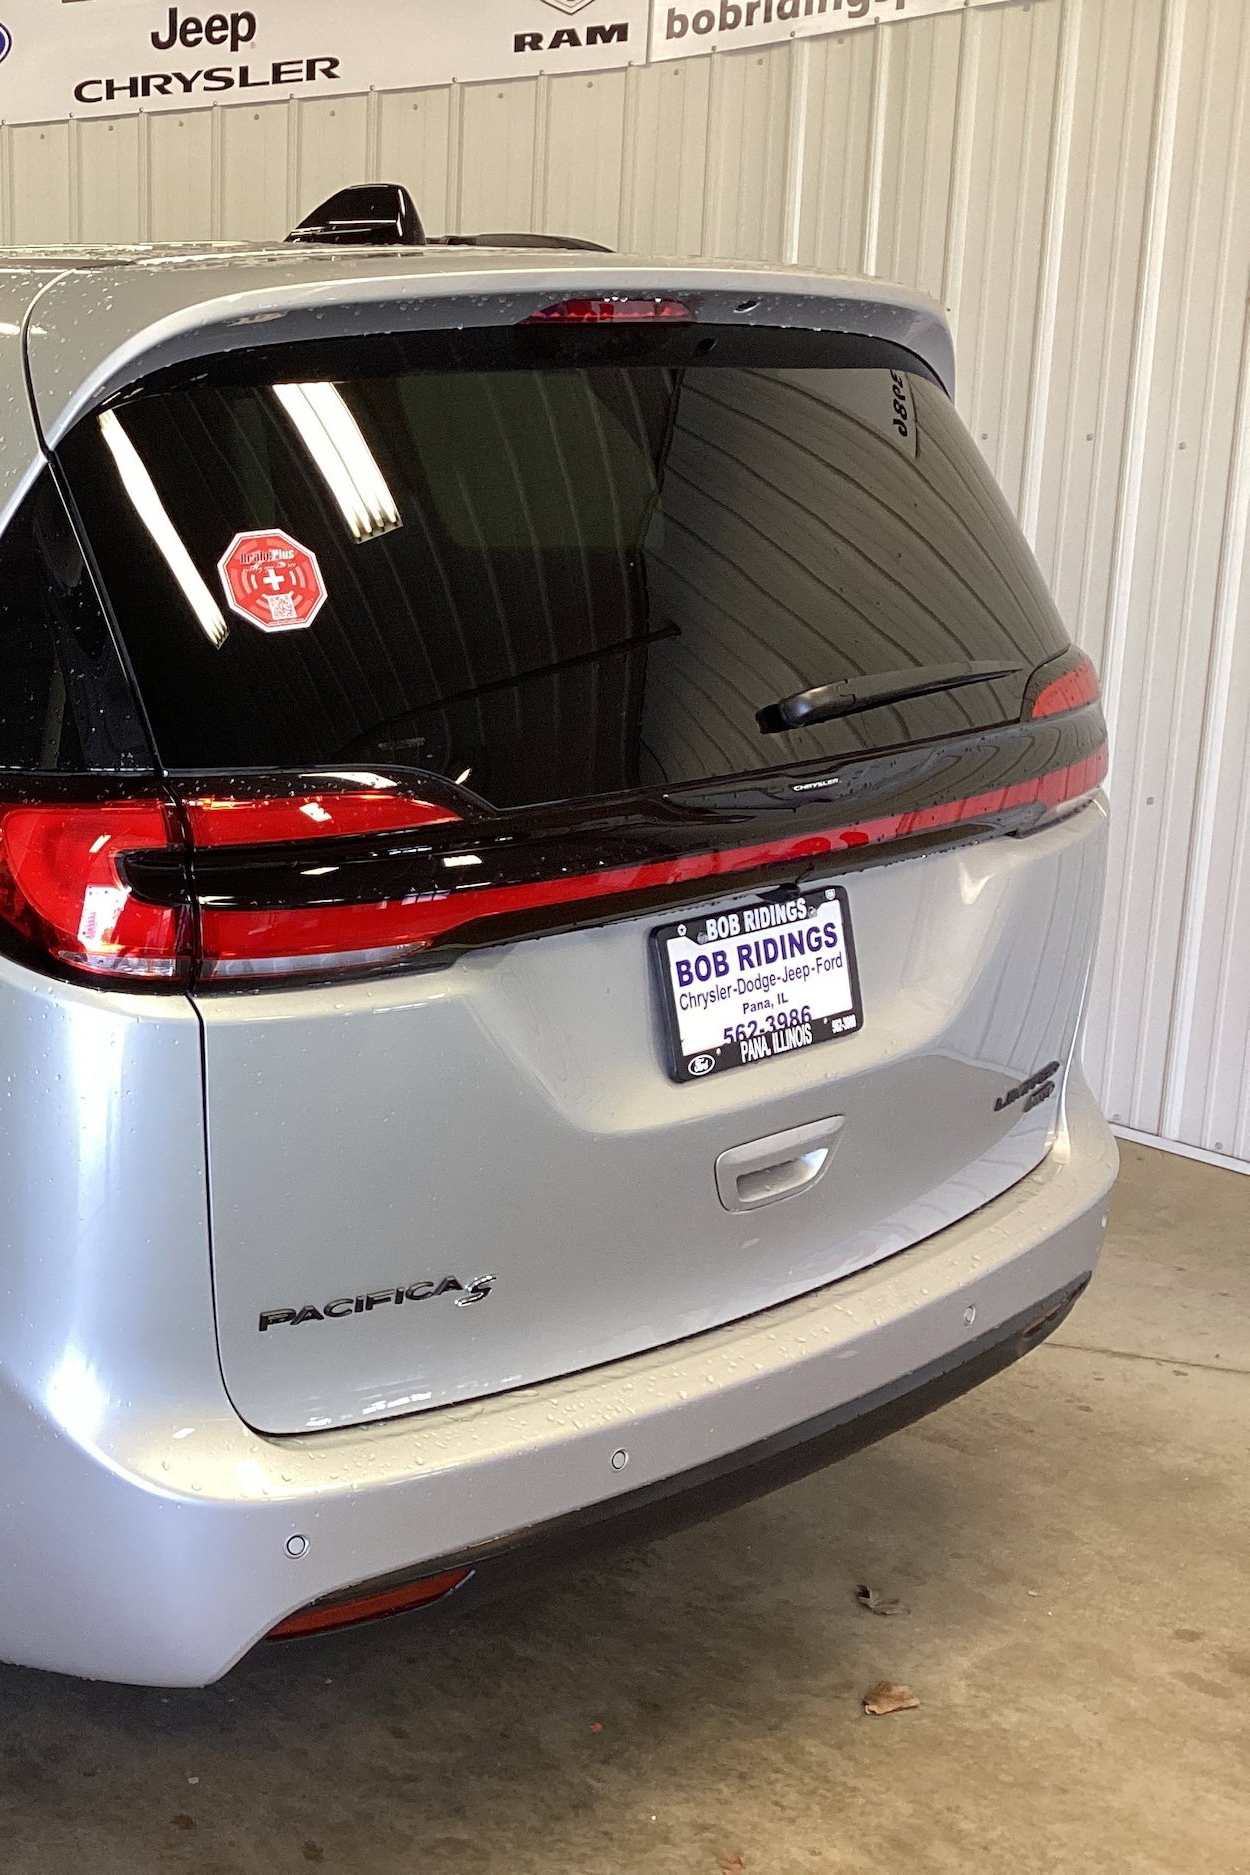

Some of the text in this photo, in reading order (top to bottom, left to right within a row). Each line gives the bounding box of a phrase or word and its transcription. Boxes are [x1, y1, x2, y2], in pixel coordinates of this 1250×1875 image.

[150, 7, 257, 52] Jeep
[513, 22, 629, 53] RAM
[665, 0, 905, 40] bobridg
[74, 56, 341, 103] CHRYSLER
[793, 778, 839, 791] CHRYSLER
[706, 898, 807, 941] BOB RIDINGS
[675, 922, 838, 988] BOB RIDINGS
[679, 952, 843, 1011] Chrysler-Dodge-Jeep-Ford
[723, 1005, 812, 1043] 562-3986
[742, 994, 789, 1015] Pana, IL
[772, 1023, 813, 1054] ILLINOIS
[258, 1273, 498, 1332] PACIFICA S
